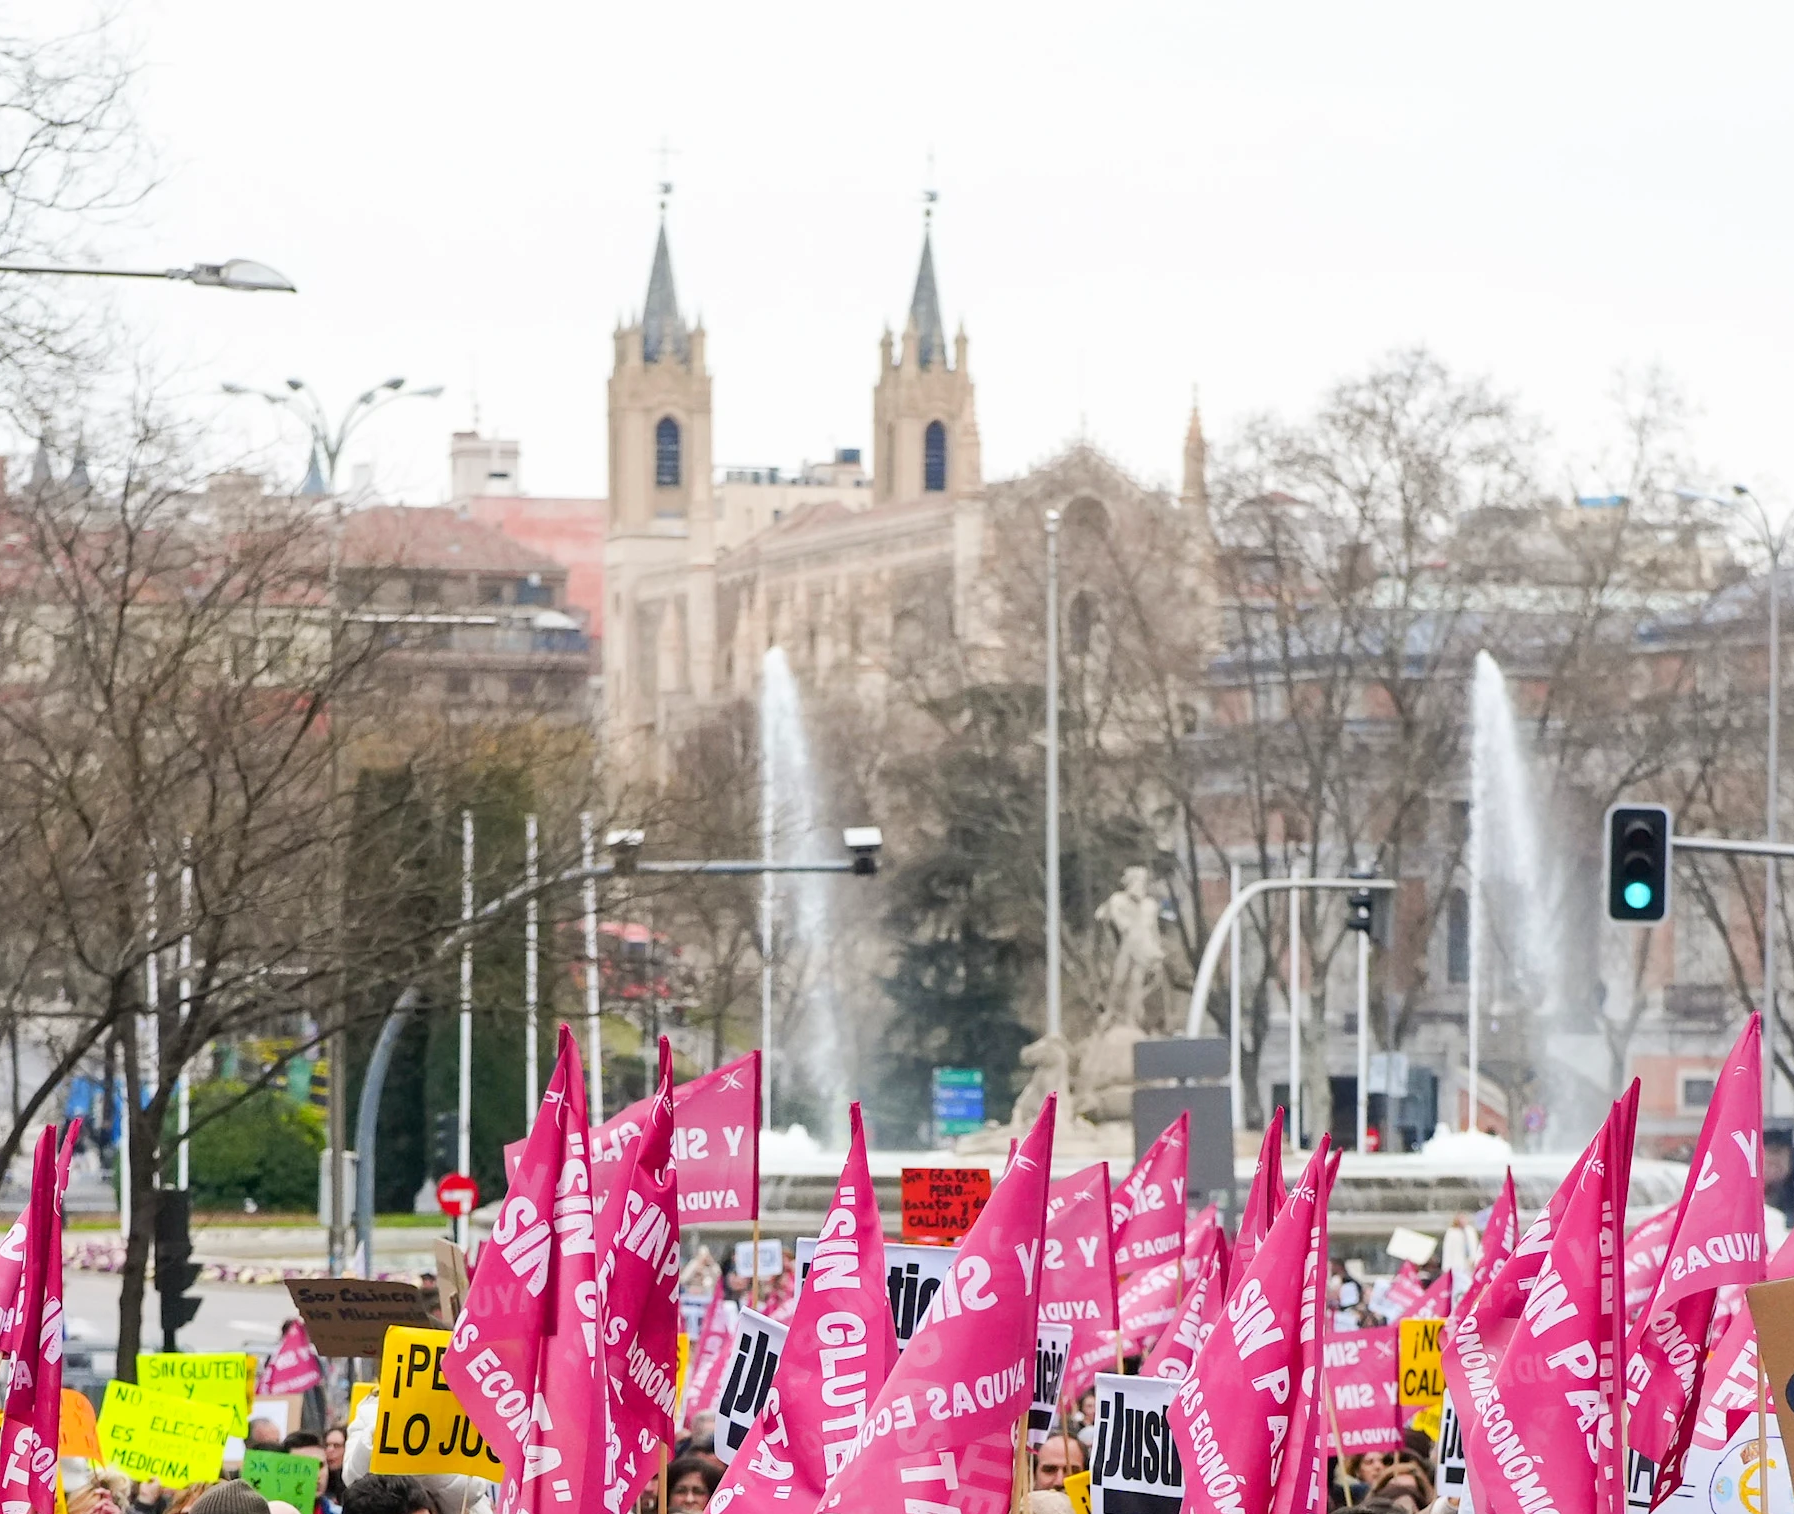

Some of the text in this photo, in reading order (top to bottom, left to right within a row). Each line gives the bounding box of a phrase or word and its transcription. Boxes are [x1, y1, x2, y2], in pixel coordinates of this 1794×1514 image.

[1227, 1277, 1286, 1361] SIN
[379, 1411, 431, 1457] LO
[111, 1446, 190, 1481] MEDICINA
